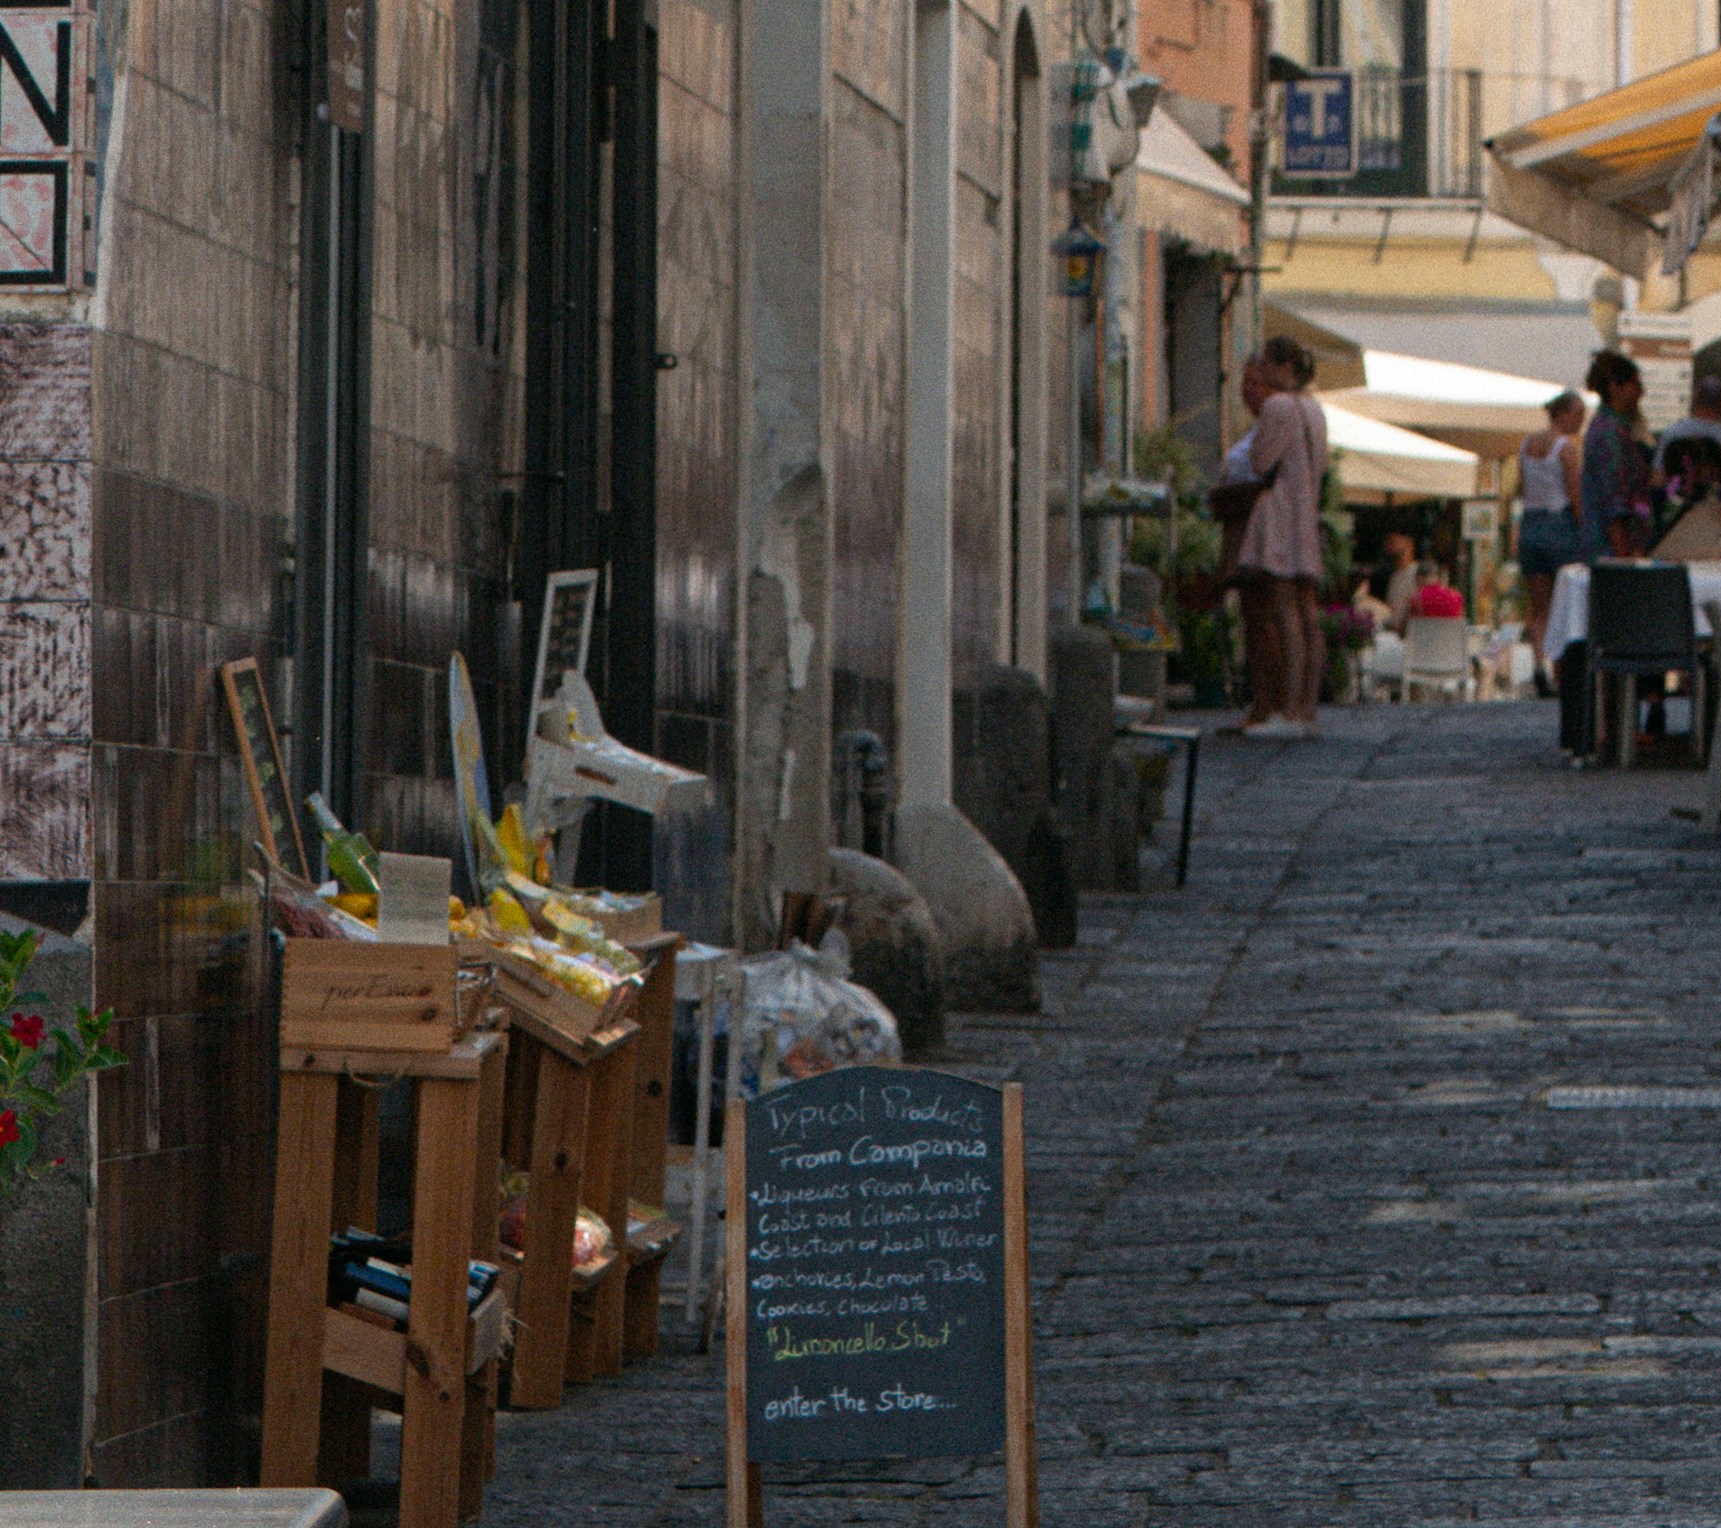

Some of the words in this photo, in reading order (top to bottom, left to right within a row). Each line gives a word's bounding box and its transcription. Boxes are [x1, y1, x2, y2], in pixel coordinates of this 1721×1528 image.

[766, 1086, 866, 1140] Typical
[758, 1213, 812, 1235] Coast
[816, 1210, 852, 1229] and
[764, 1386, 828, 1422] enter
